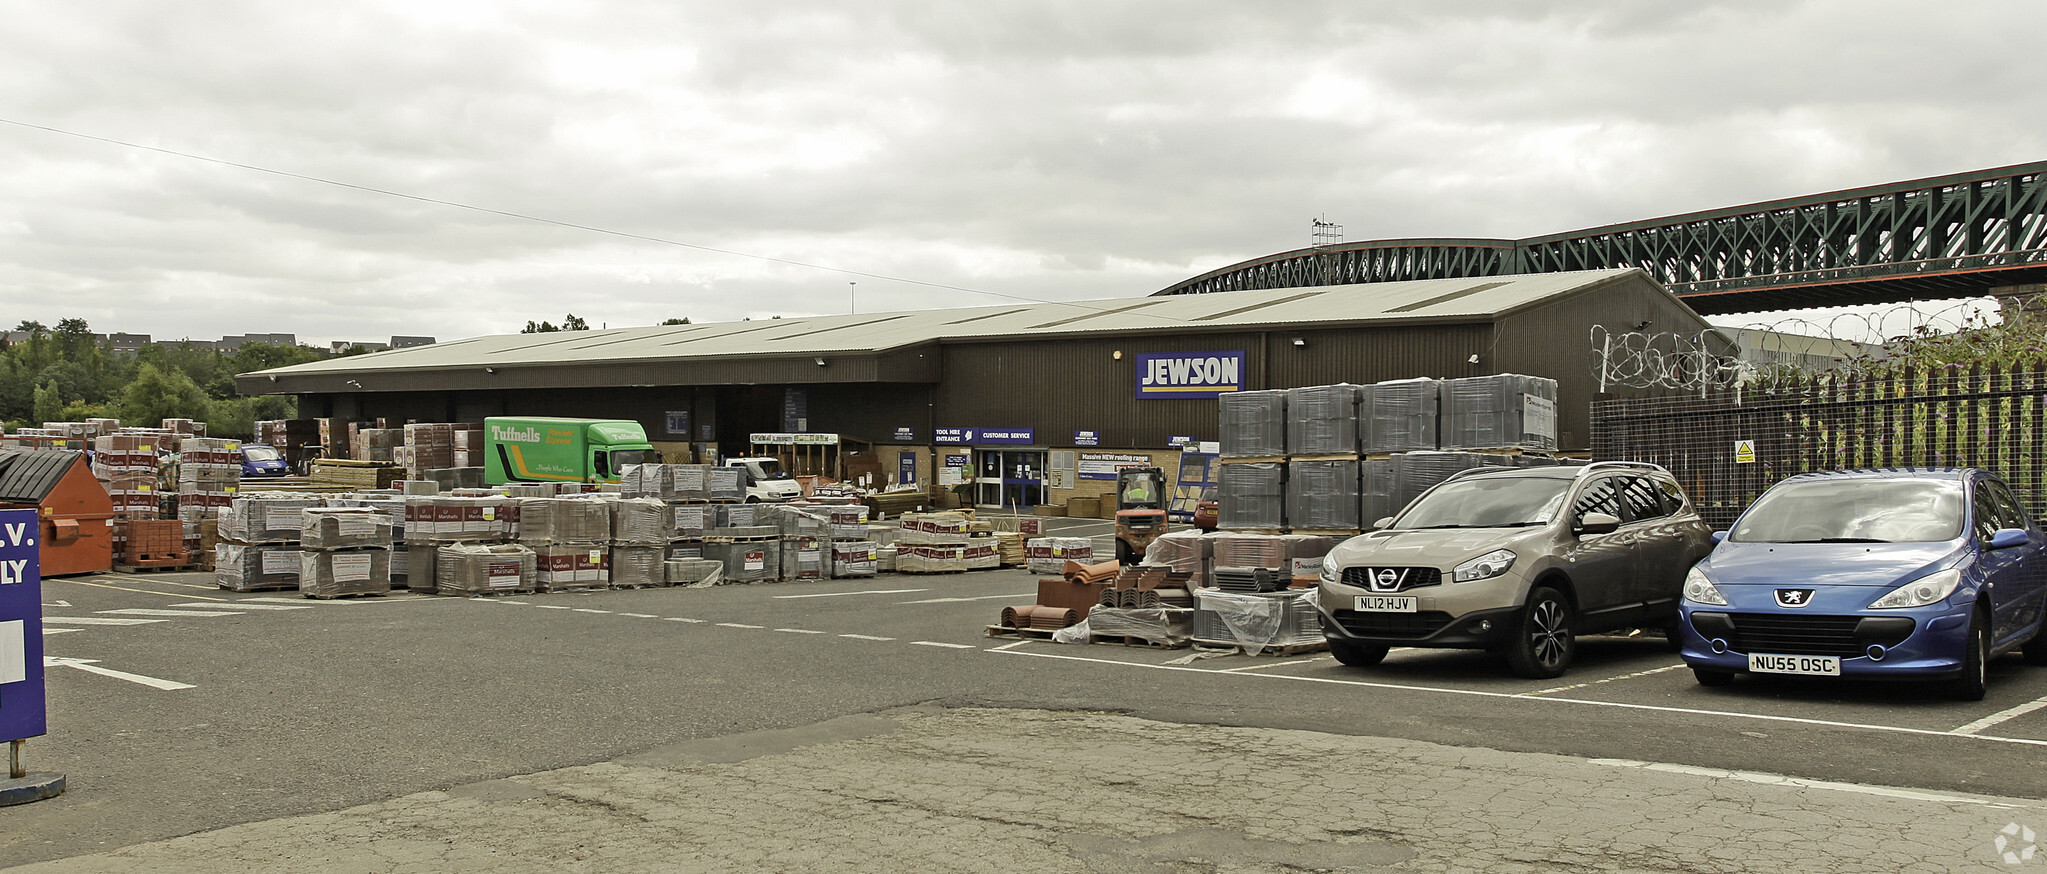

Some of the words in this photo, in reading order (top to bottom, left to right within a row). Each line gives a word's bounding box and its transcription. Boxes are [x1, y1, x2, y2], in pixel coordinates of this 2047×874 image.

[1141, 357, 1239, 385] JEWSON
[491, 425, 541, 443] Tuffnells
[1360, 597, 1384, 610] NL12
[1387, 597, 1409, 610] HJV
[1755, 656, 1796, 671] NU55
[1800, 658, 1833, 672] OSC
